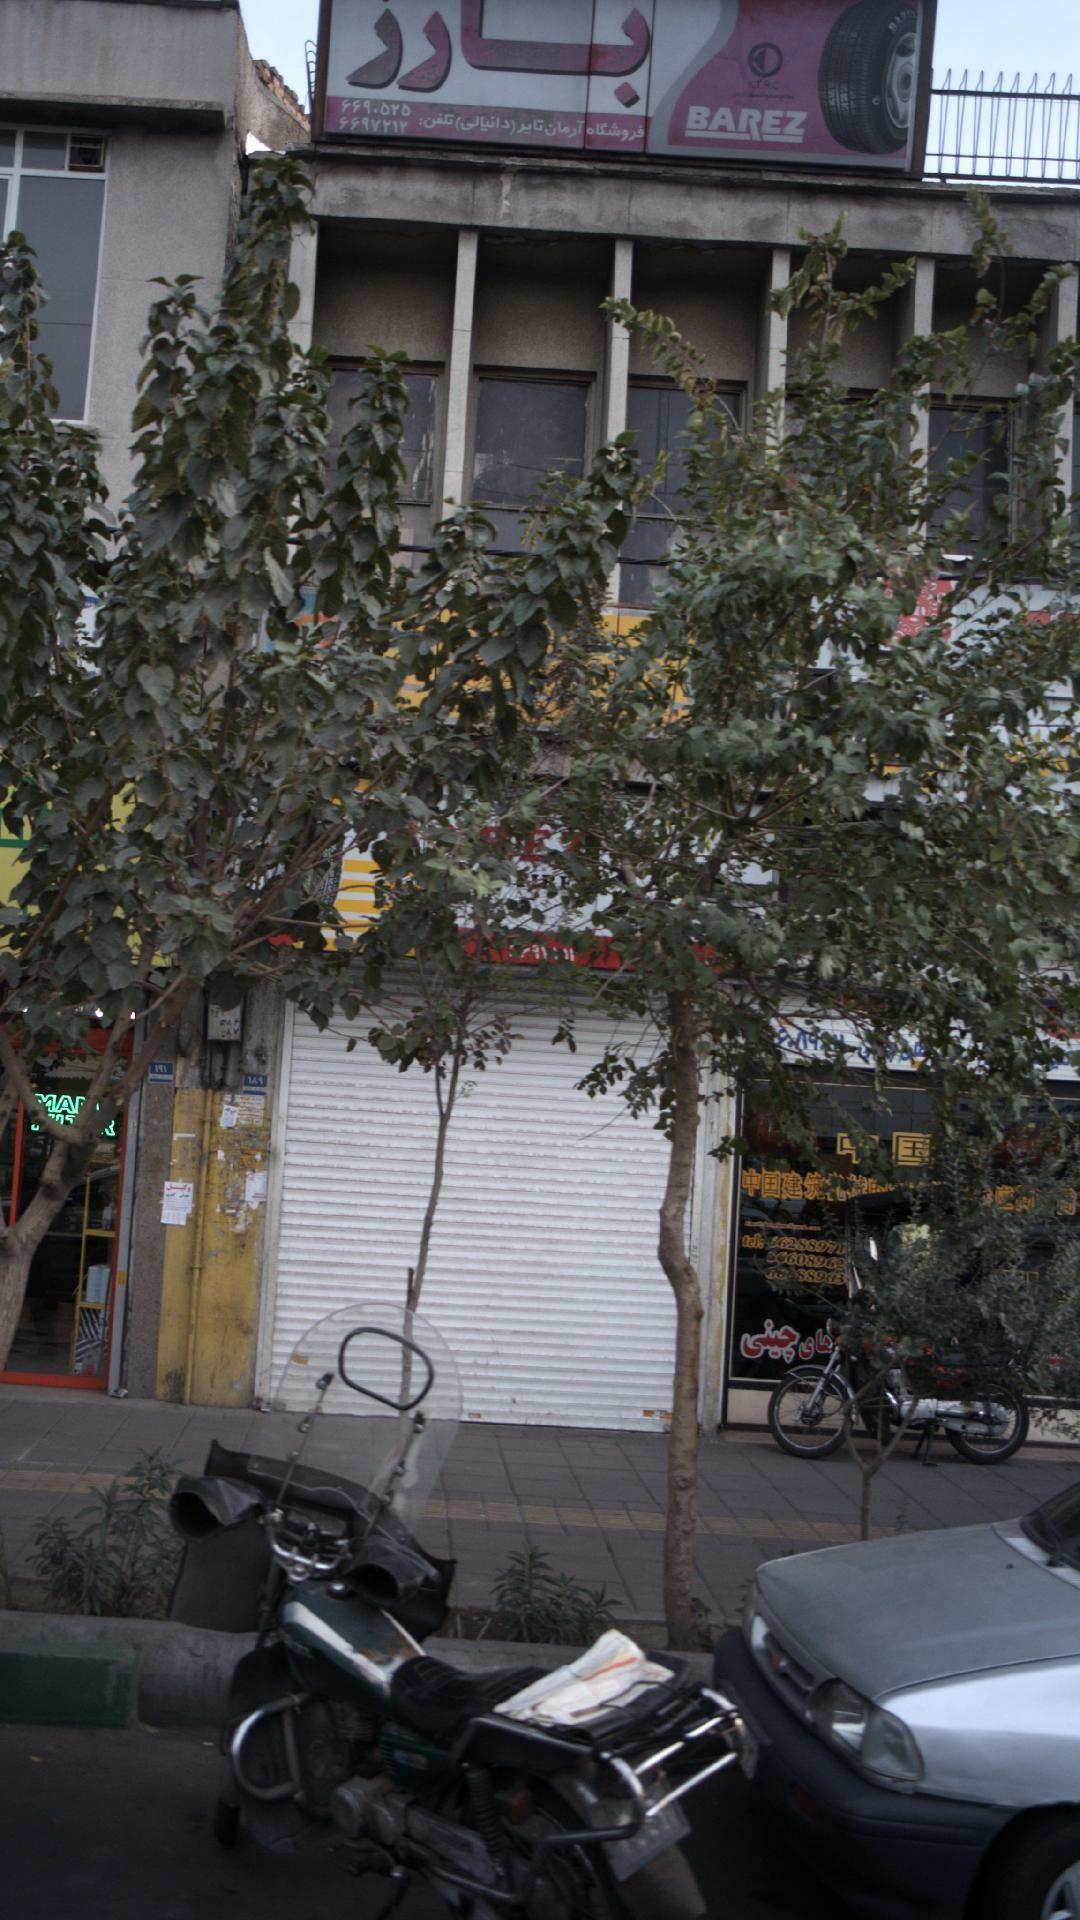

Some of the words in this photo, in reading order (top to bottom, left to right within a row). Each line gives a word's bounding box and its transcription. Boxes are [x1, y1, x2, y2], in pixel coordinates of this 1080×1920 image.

[516, 119, 544, 134] تایر
[544, 120, 584, 138] آرمان
[586, 122, 645, 141] فروشگاه
[685, 105, 808, 143] BAREZ
[741, 1319, 800, 1364] چینی
